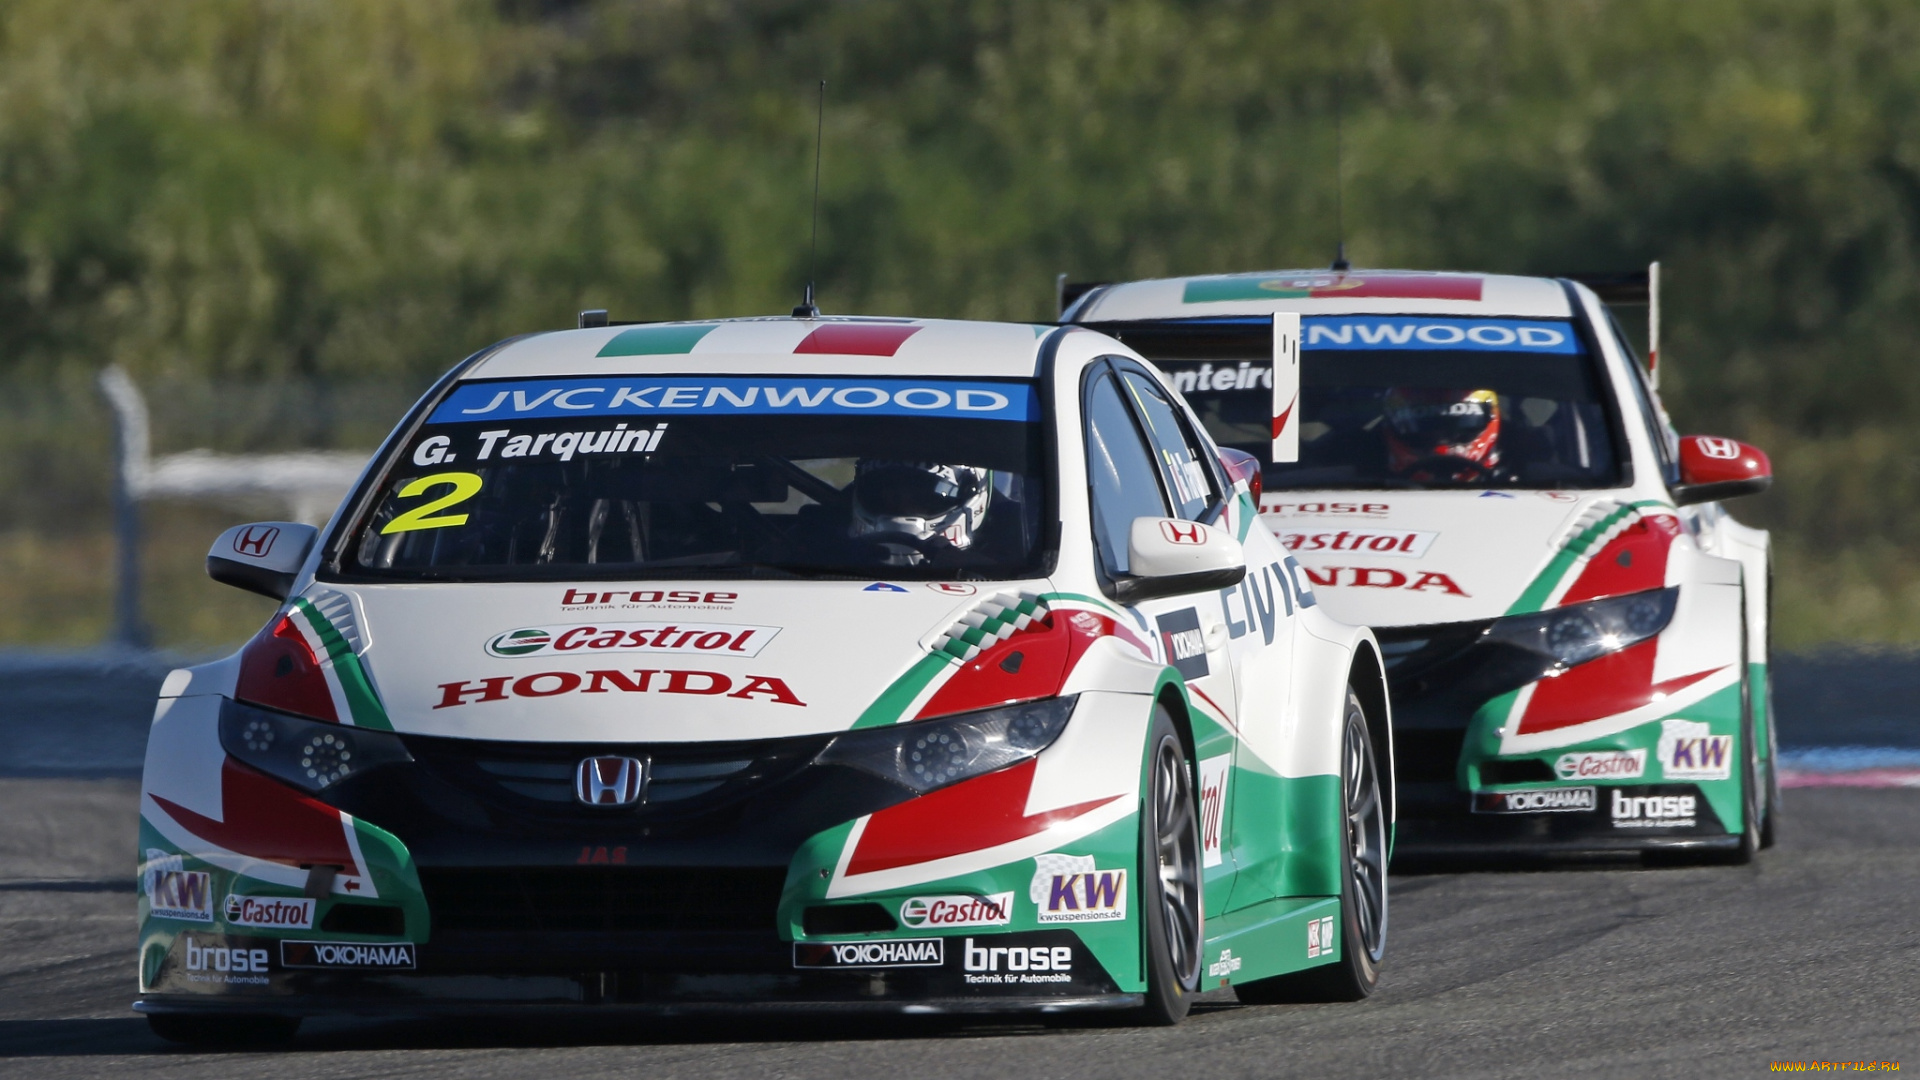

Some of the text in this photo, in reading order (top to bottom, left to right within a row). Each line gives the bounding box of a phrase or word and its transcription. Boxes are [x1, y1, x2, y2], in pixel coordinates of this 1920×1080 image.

[413, 423, 669, 466] G. Tarquini
[380, 472, 483, 535] 2
[1272, 531, 1418, 553] astrol
[1304, 566, 1473, 598] NDA
[561, 588, 738, 605] brose
[646, 603, 733, 611] Automobile
[552, 625, 757, 652] Castrol
[432, 669, 808, 710] HONDA
[1579, 753, 1641, 776] Castrol
[1672, 736, 1729, 768] KW
[1505, 789, 1590, 810] YOKOHAMA
[1611, 788, 1696, 818] brose
[577, 846, 628, 865] JAS
[154, 869, 209, 911] KW
[1048, 871, 1125, 912] KW
[242, 898, 309, 925] Castrol
[929, 896, 1007, 924] Castrol
[1038, 909, 1122, 922] kwsuspensions.de
[187, 937, 269, 972] brose
[314, 945, 412, 965] YOKOHAMA
[832, 942, 938, 964] YOKOHAMA
[964, 938, 1072, 971] brose
[224, 974, 270, 985] Automobile
[964, 973, 1072, 984] Technik für Automobile
